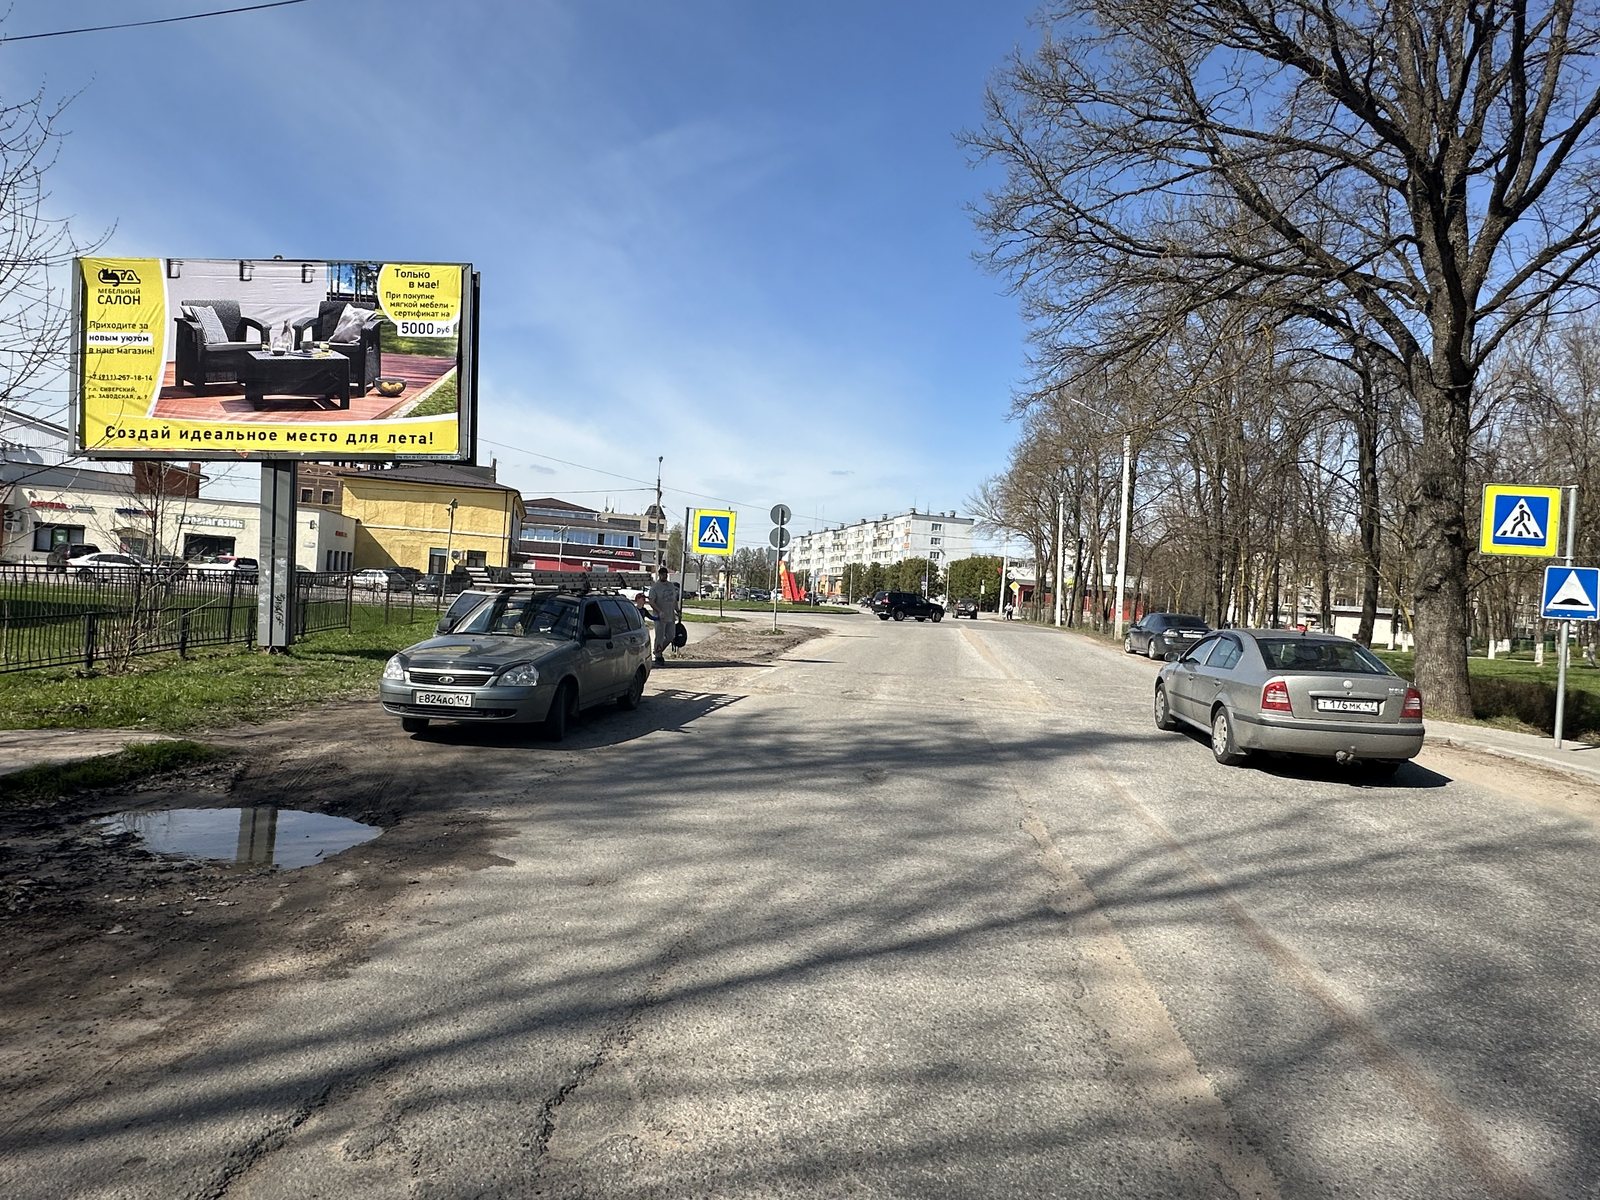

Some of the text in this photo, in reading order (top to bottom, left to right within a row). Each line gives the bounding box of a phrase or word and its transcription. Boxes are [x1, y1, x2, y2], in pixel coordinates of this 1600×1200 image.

[394, 268, 430, 278] Только
[417, 280, 440, 289] мае!
[97, 295, 141, 305] САЛОН
[385, 291, 435, 301] При покупке
[420, 301, 449, 309] мебели
[394, 310, 440, 318] сертификат
[89, 320, 137, 330] Приходите
[401, 322, 450, 335] 5000 руб
[121, 335, 149, 343] уютом
[117, 347, 155, 355] магазин!
[105, 426, 434, 445] Создай идеальное место для лета!
